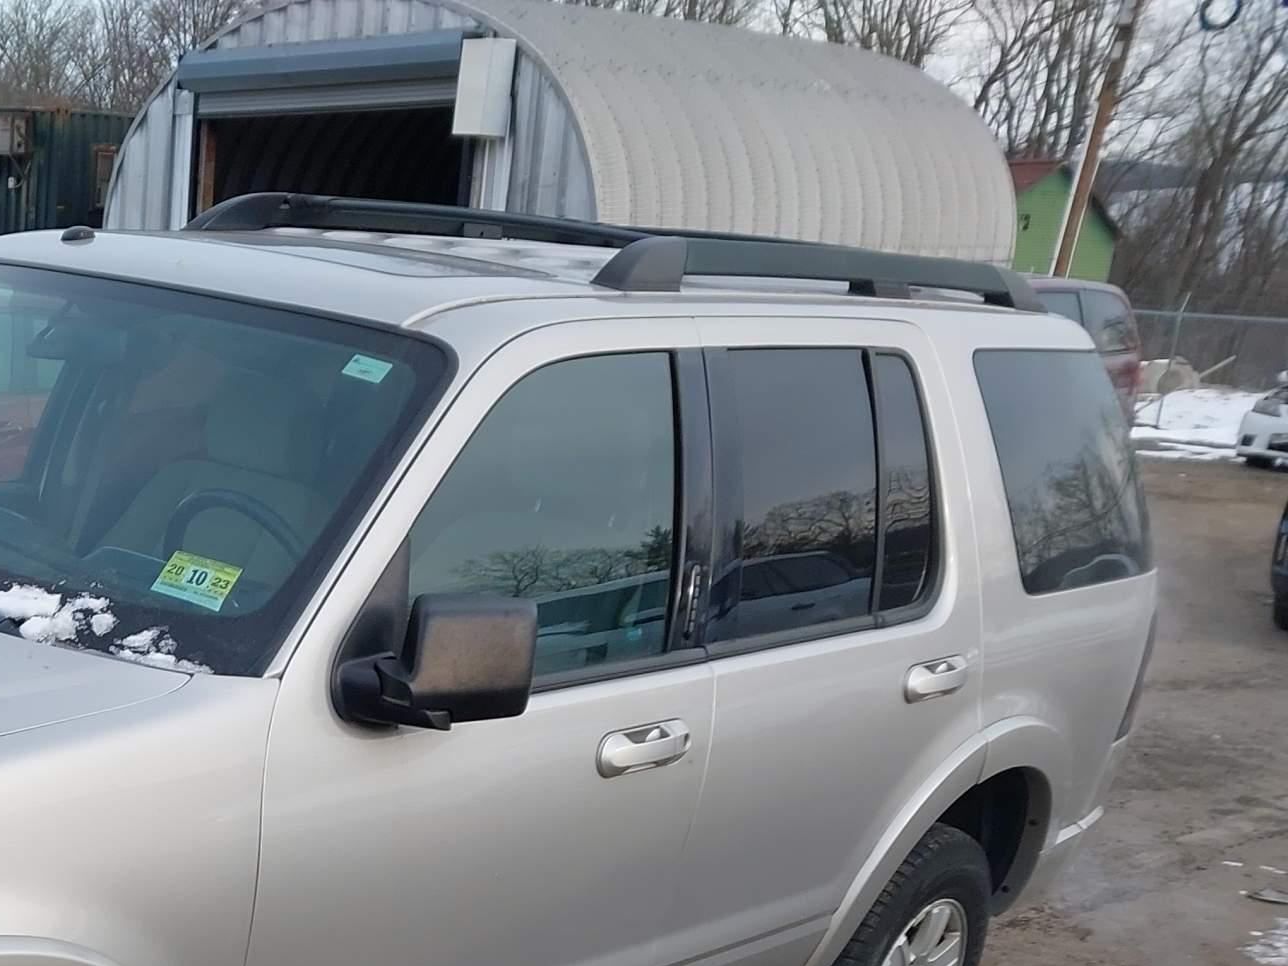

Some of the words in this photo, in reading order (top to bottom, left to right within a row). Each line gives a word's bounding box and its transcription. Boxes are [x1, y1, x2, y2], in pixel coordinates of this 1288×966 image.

[167, 563, 185, 576] 20
[186, 568, 209, 587] 10
[211, 577, 231, 590] 23
